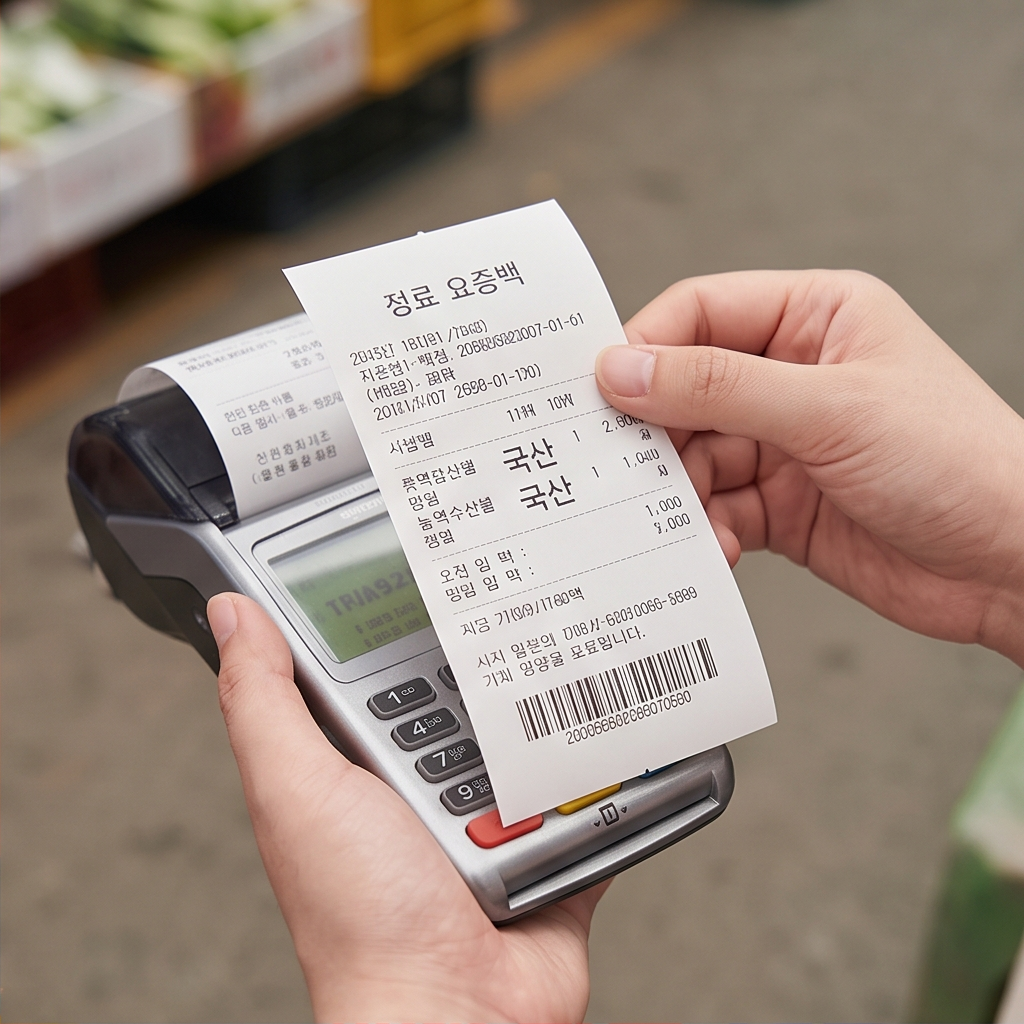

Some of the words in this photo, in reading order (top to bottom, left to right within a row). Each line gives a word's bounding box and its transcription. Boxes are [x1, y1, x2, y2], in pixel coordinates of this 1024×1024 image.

[383, 284, 440, 317] 정료
[446, 260, 525, 300] 요증백
[502, 438, 558, 473] 국산
[519, 475, 576, 511] 국산
[645, 495, 683, 517] 1,000
[387, 691, 402, 704] 1
[413, 720, 427, 735] 4
[432, 751, 446, 767] 7
[457, 784, 474, 800] 9
